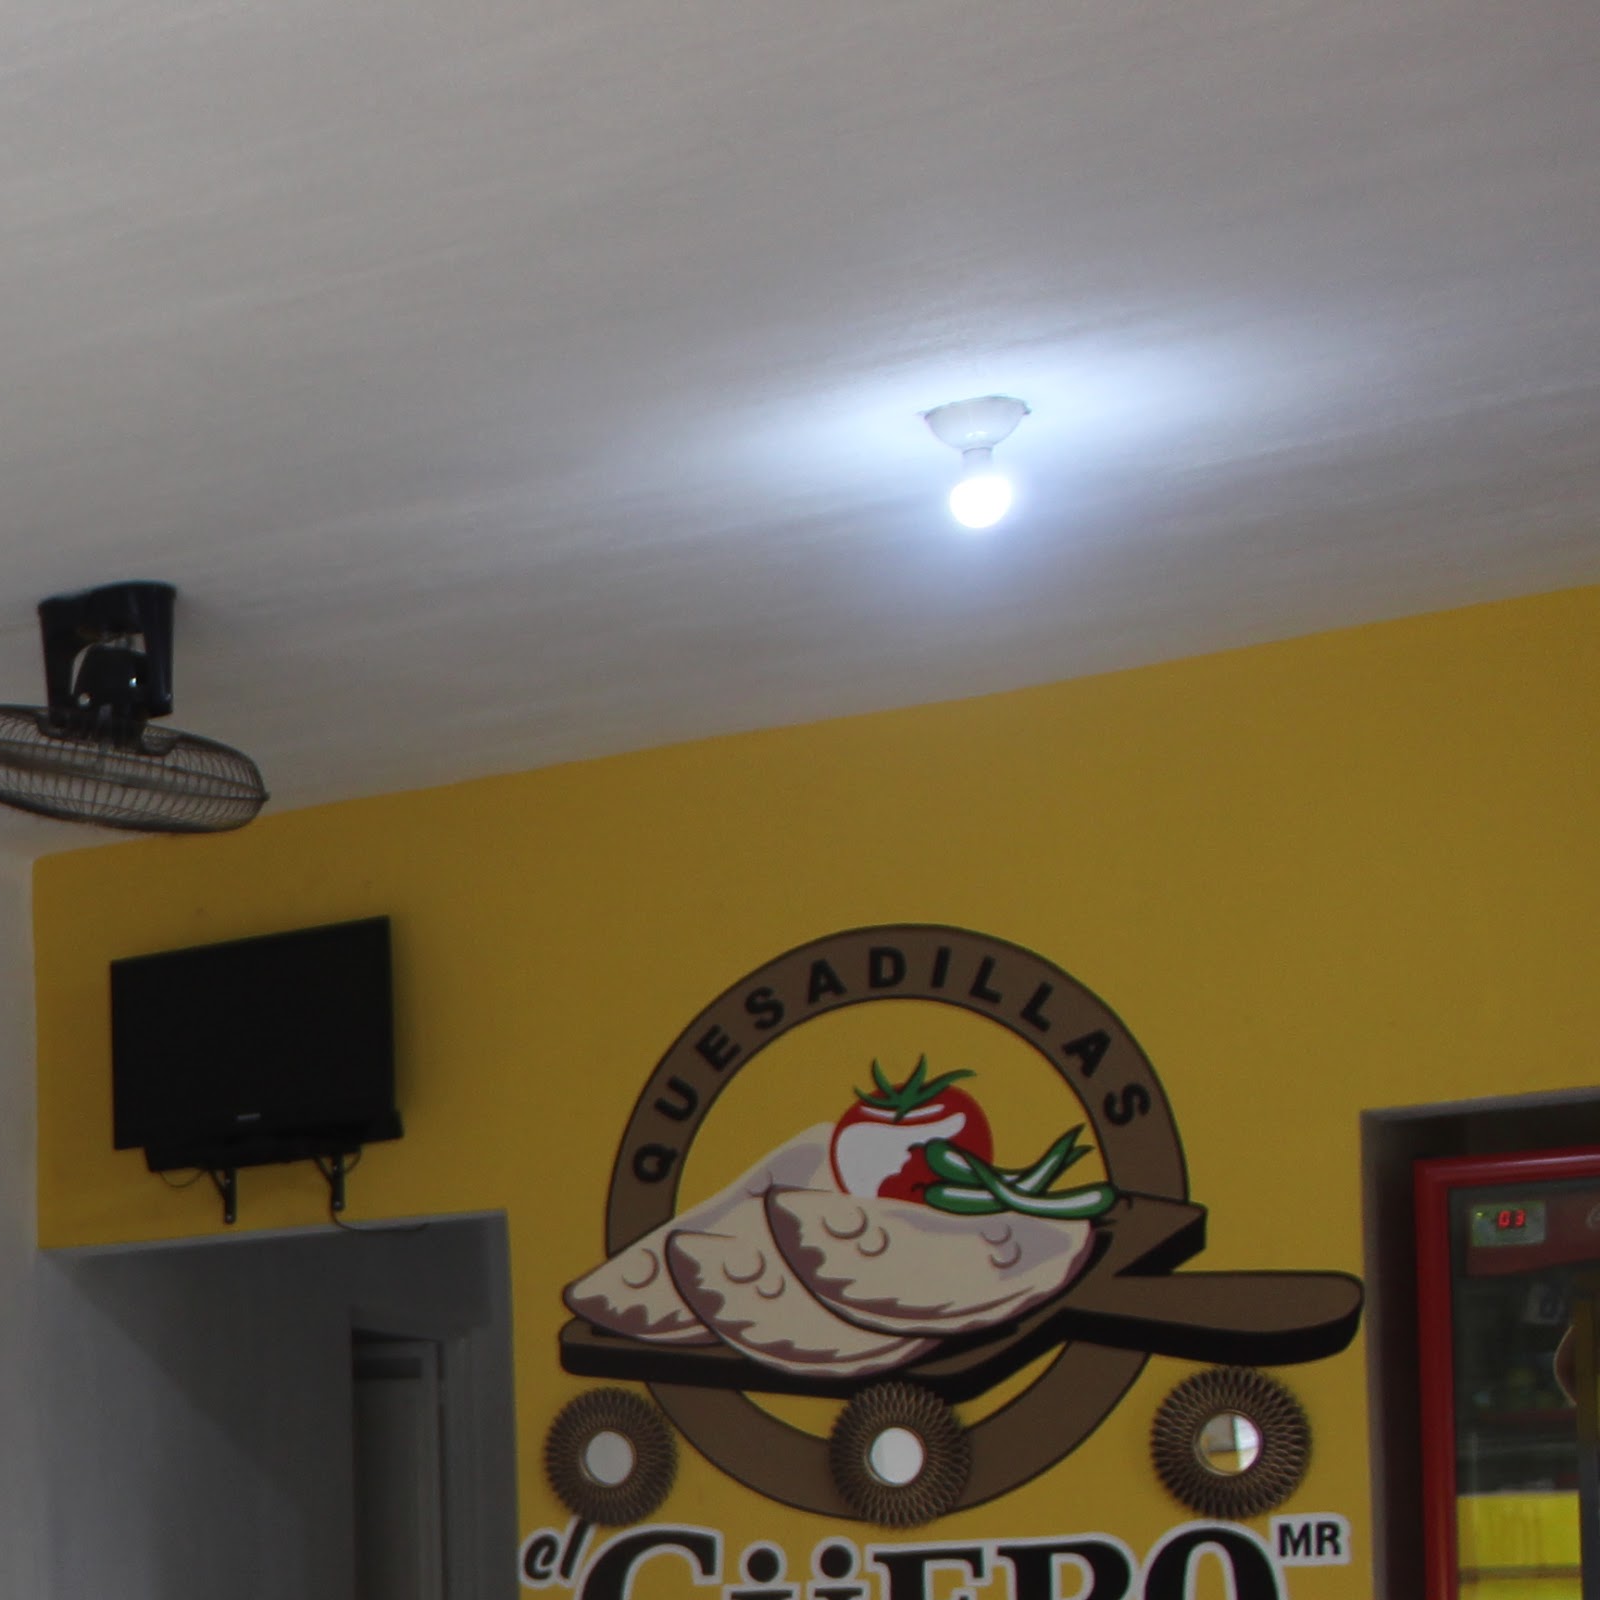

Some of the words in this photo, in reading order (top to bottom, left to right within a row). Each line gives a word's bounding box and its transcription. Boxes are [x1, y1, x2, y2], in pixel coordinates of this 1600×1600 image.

[630, 946, 1152, 1187] QUESADILLAS
[524, 1517, 592, 1580] el
[1279, 1521, 1341, 1557] MR
